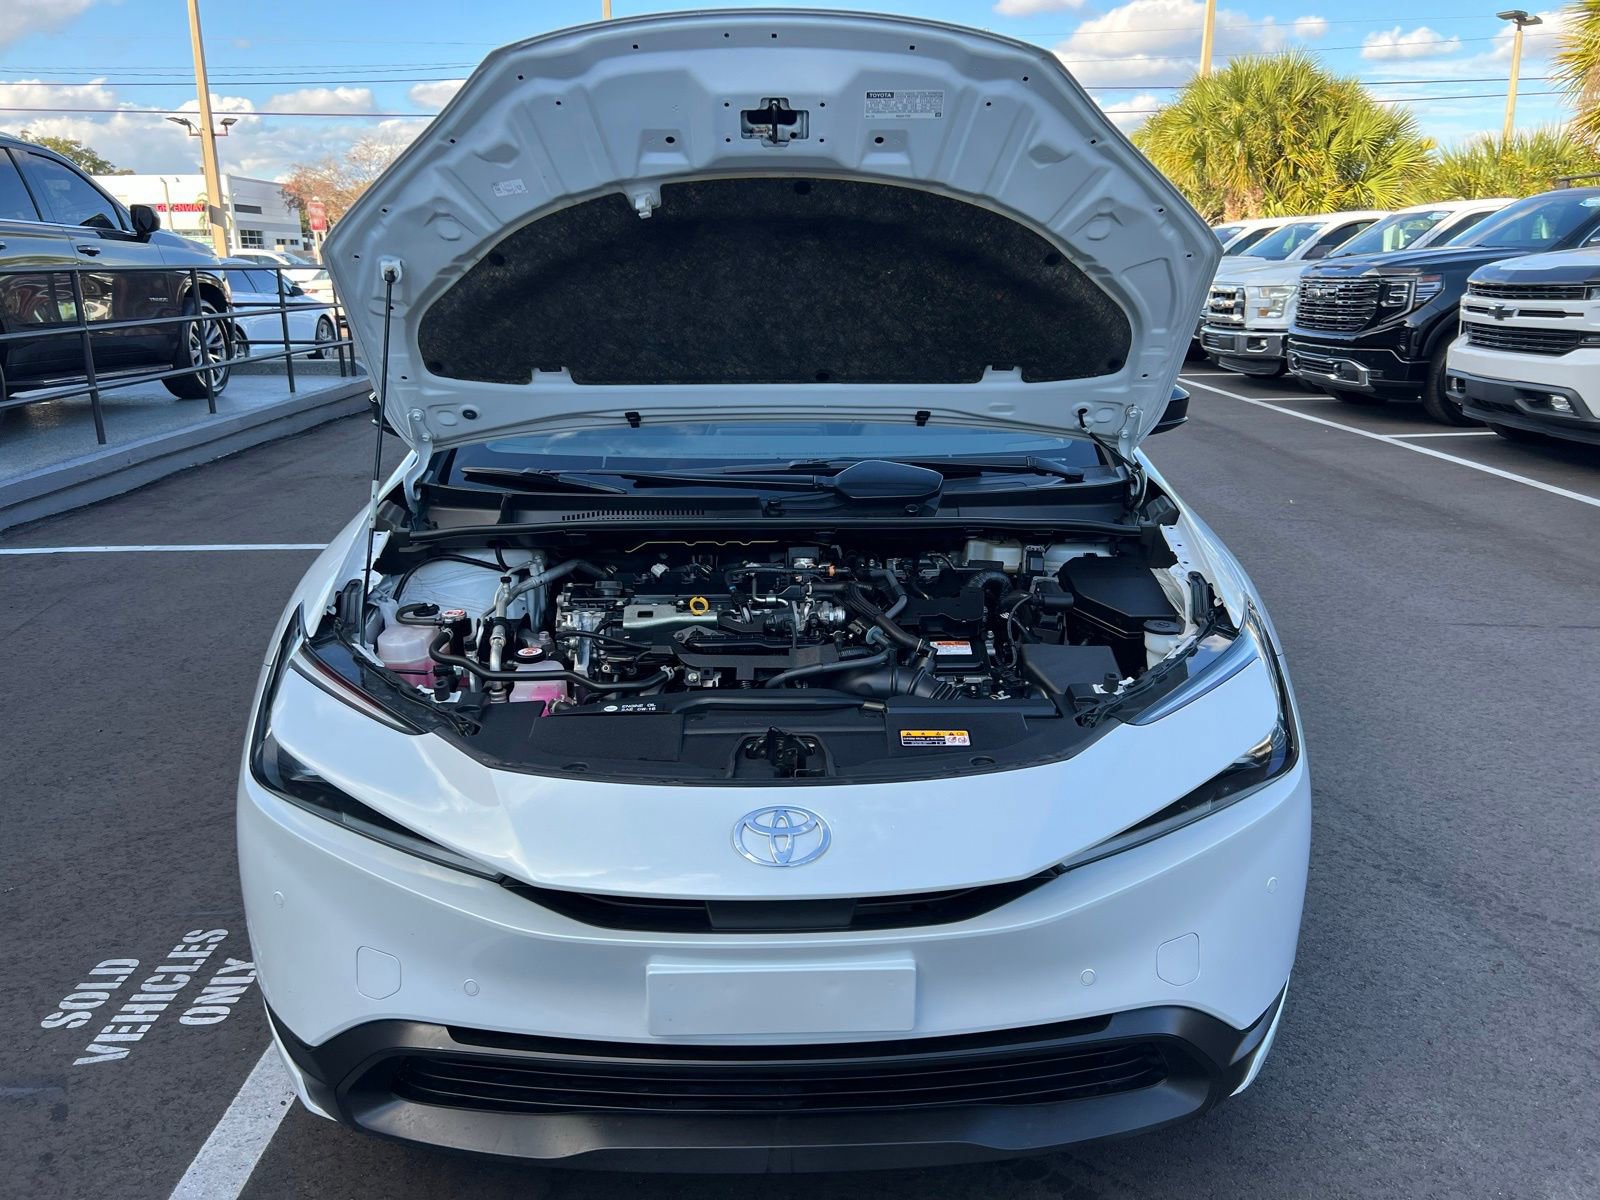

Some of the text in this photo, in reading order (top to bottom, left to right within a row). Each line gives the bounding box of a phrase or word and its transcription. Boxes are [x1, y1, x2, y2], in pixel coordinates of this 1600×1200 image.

[156, 203, 205, 212] GRENWAY
[40, 958, 140, 1029] SOLD
[72, 928, 229, 1066] VEHICLES
[179, 957, 256, 1026] ONLY
